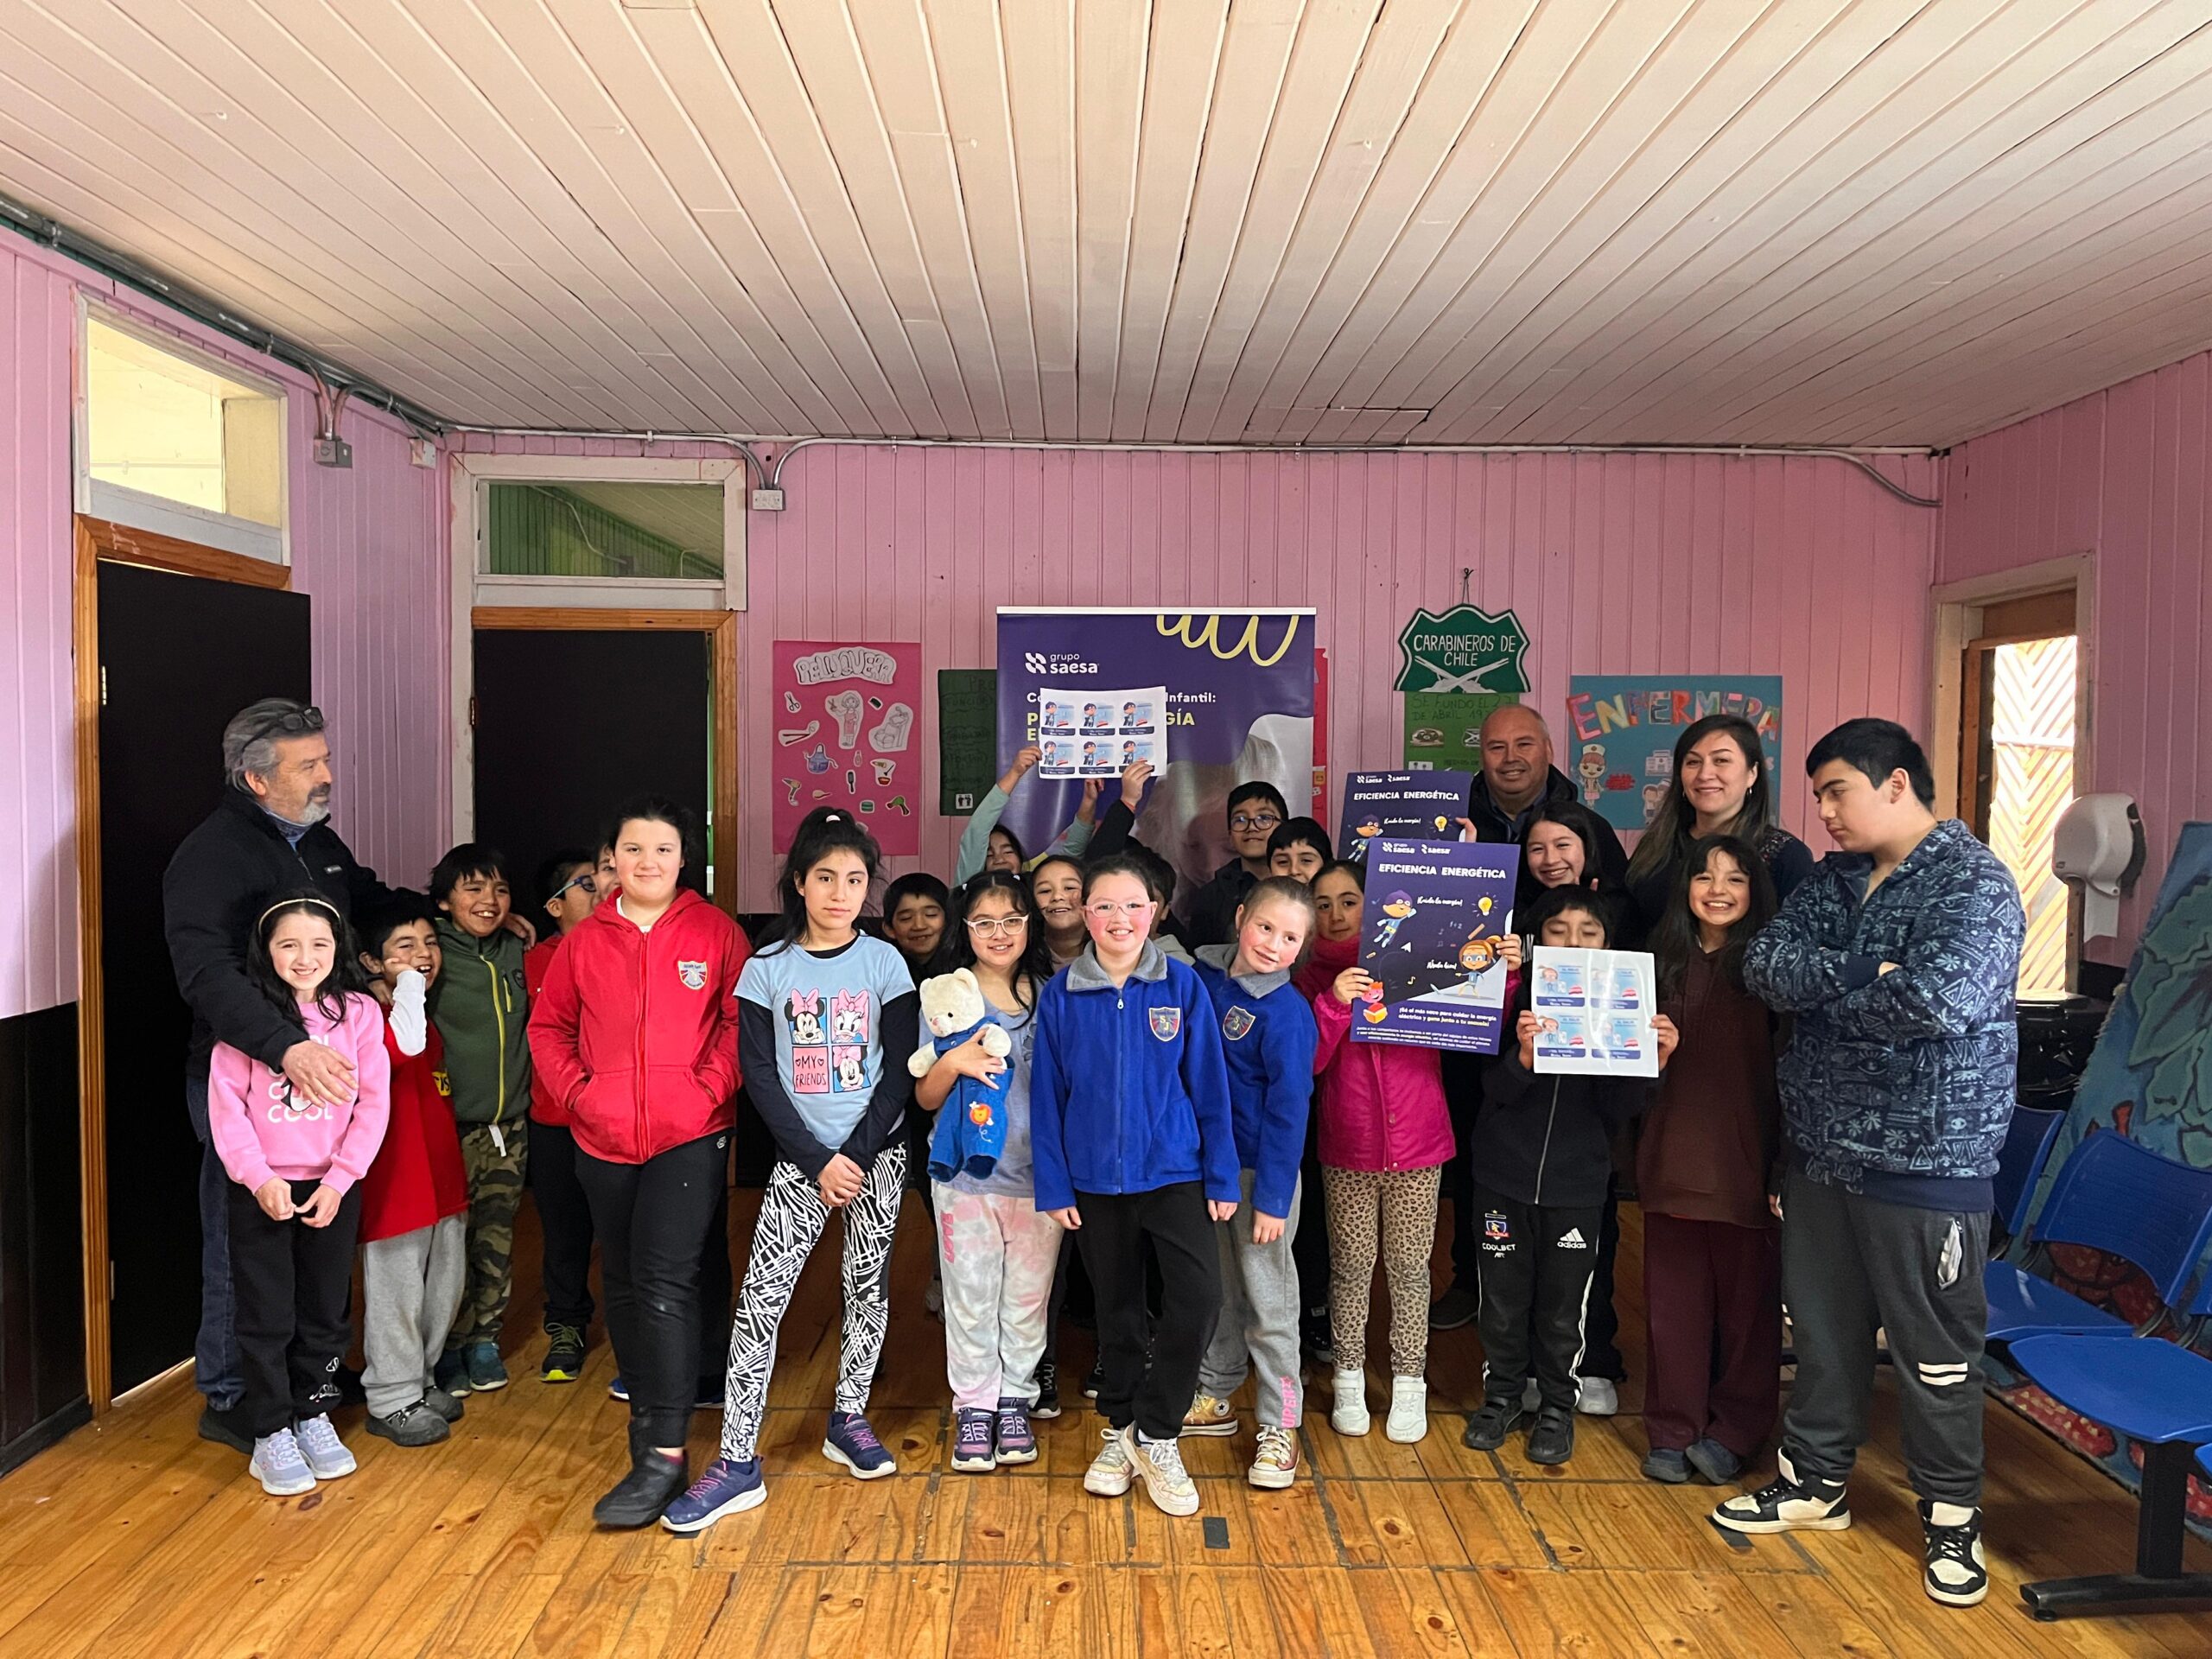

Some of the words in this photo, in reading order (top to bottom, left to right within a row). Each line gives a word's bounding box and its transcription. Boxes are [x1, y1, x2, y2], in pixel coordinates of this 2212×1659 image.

[1413, 634, 1496, 652] CARABINEROS
[1501, 635, 1516, 652] DE
[1050, 652, 1080, 663] grupo
[1444, 652, 1478, 667] CHILE
[1050, 663, 1098, 674] saesa
[1353, 791, 1400, 801] EFICIENCIA
[1403, 790, 1459, 801] ENERGÉTICA
[1378, 863, 1437, 874] EFICIENCIA
[1441, 867, 1506, 879] ENERGÉTICA
[801, 1055, 817, 1069] MY
[796, 1072, 827, 1088] FRIENDS
